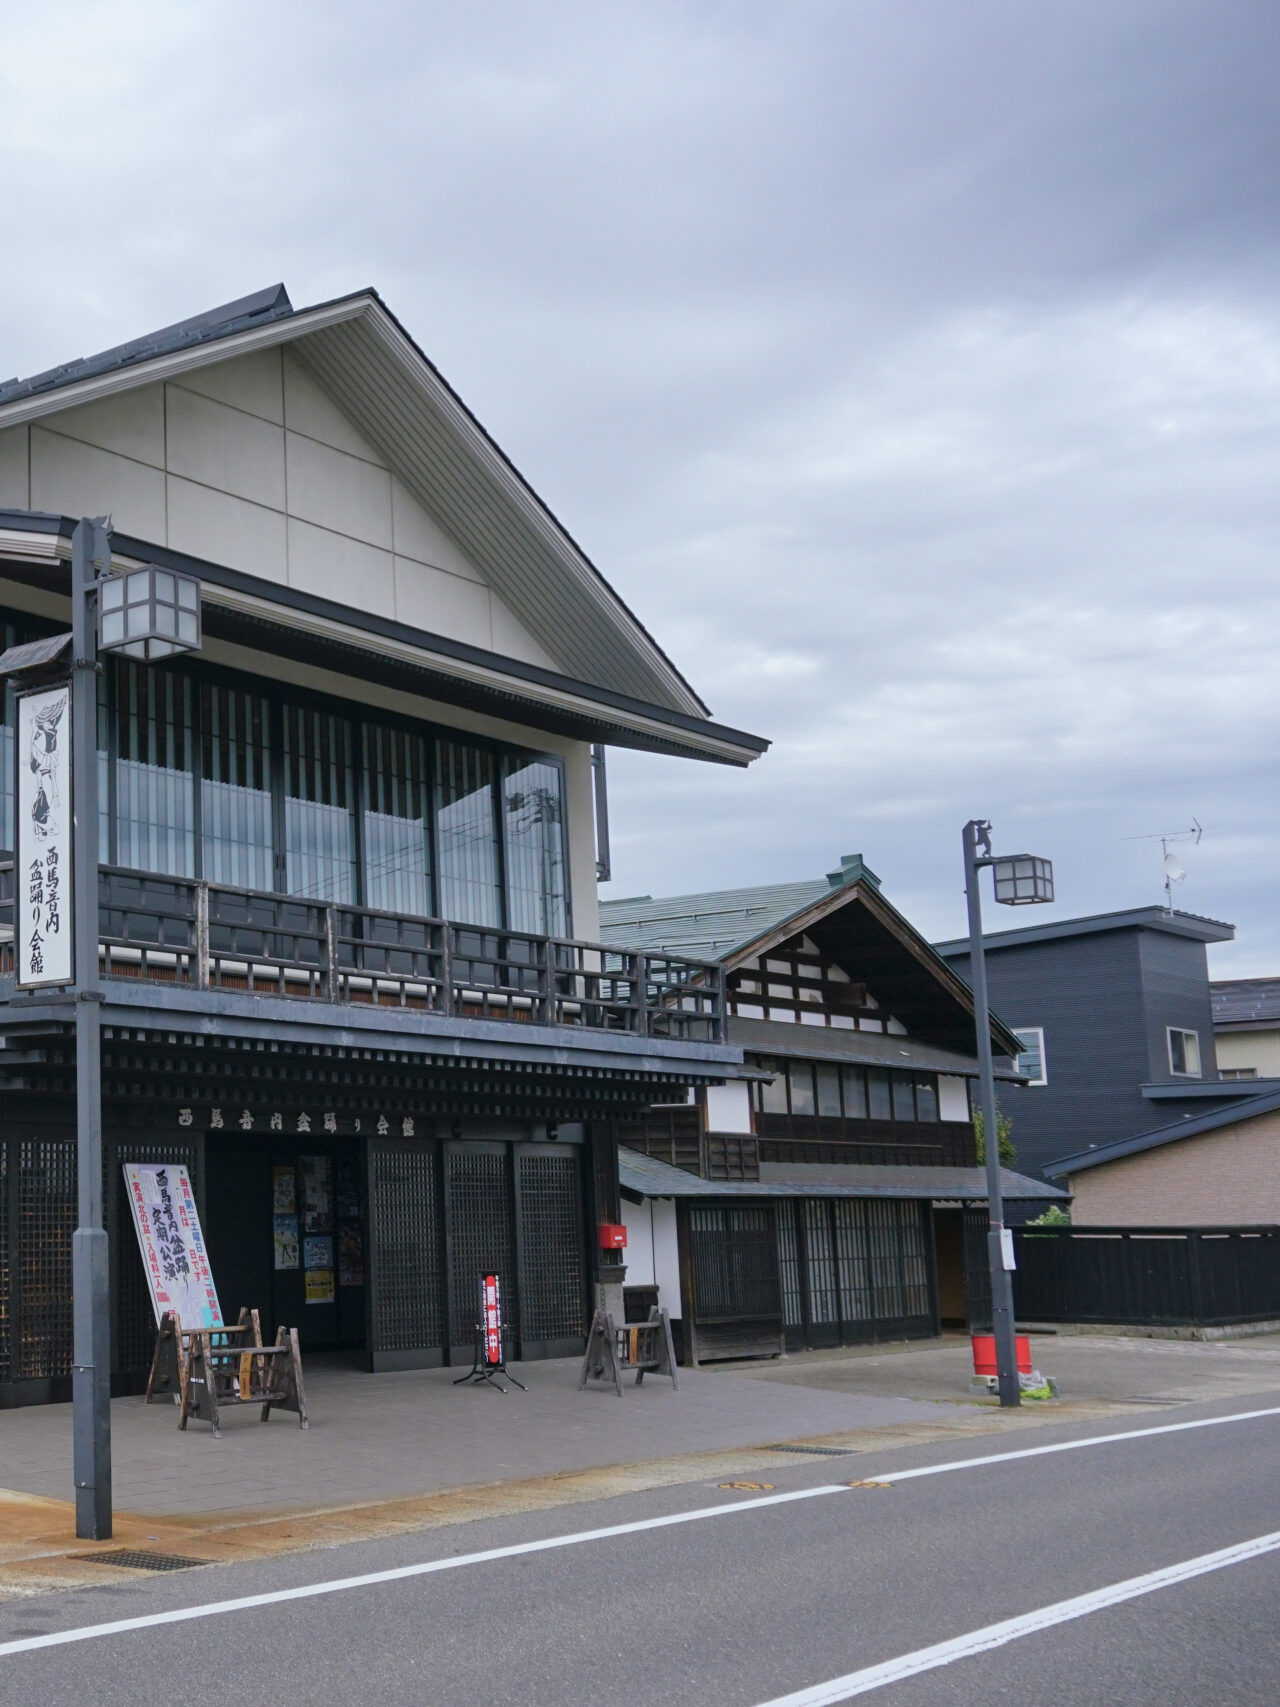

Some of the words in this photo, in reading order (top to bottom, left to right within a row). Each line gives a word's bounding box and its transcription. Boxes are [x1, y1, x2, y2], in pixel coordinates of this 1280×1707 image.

[29, 859, 45, 975] 盆踊り会館
[45, 846, 60, 934] 西馬音内
[178, 1108, 414, 1137] 西馬音内盆踊り会館
[152, 1207, 179, 1281] 定期公演
[189, 1250, 202, 1281] 日です
